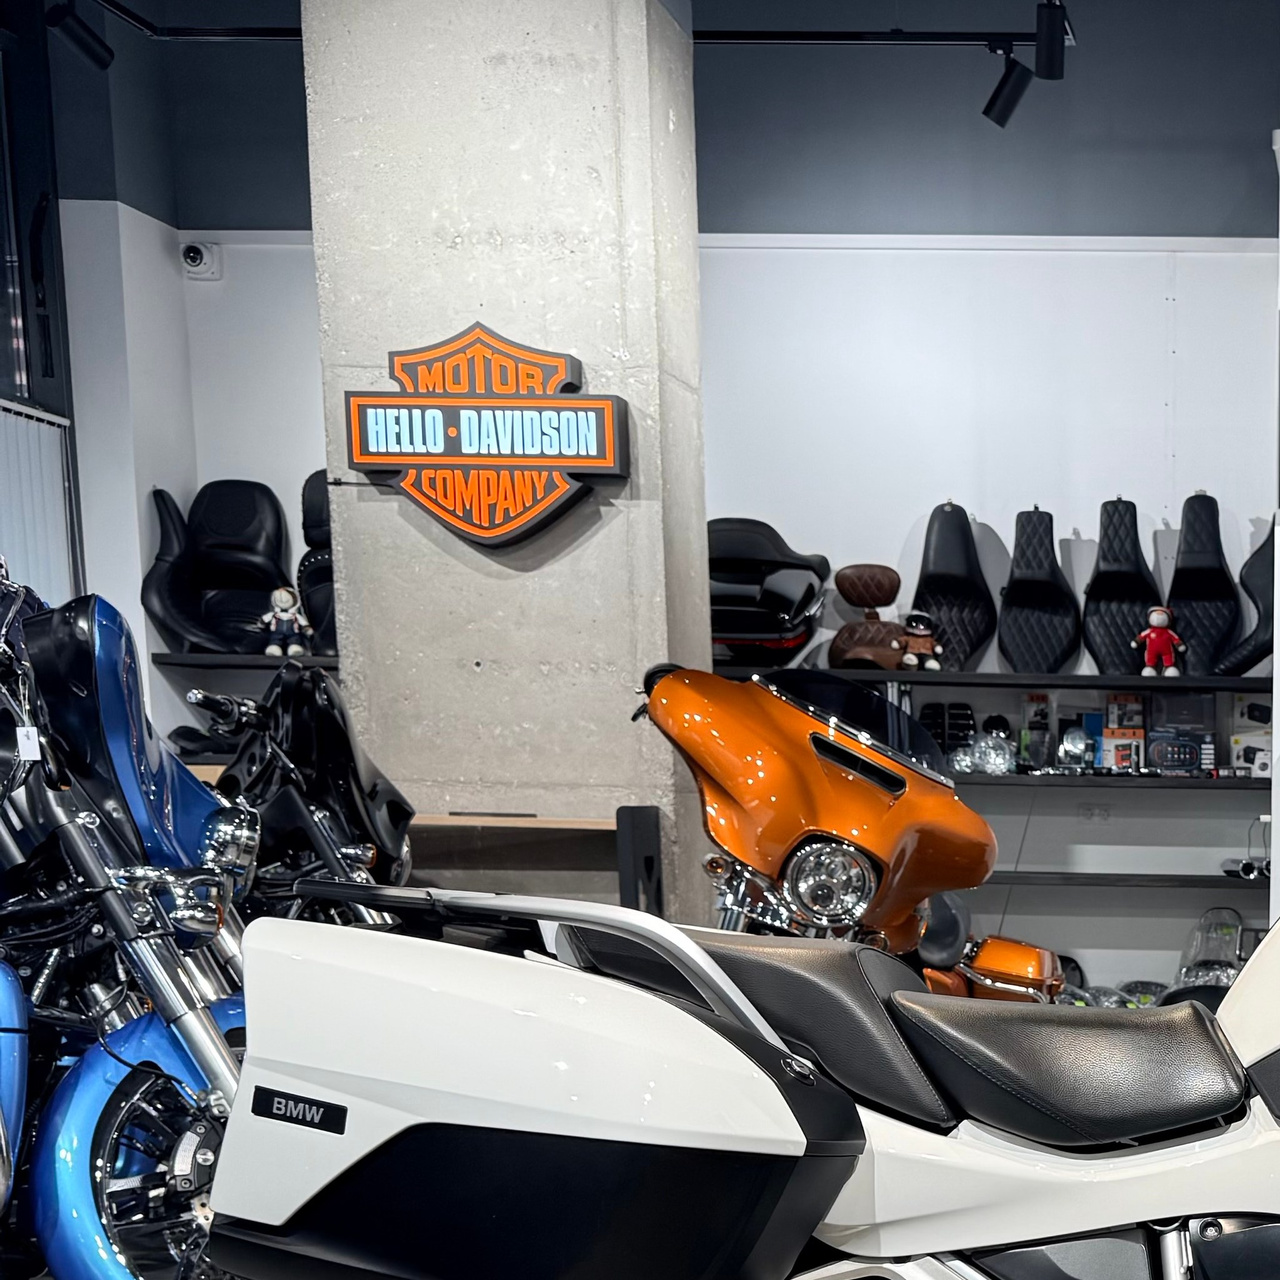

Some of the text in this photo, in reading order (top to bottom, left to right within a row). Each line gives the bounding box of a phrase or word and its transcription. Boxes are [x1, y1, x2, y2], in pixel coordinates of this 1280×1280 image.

[417, 342, 543, 394] MOTOR
[366, 408, 598, 456] HELLO DAVIDSON
[421, 469, 549, 527] COMPANY
[272, 1096, 325, 1124] BMW
